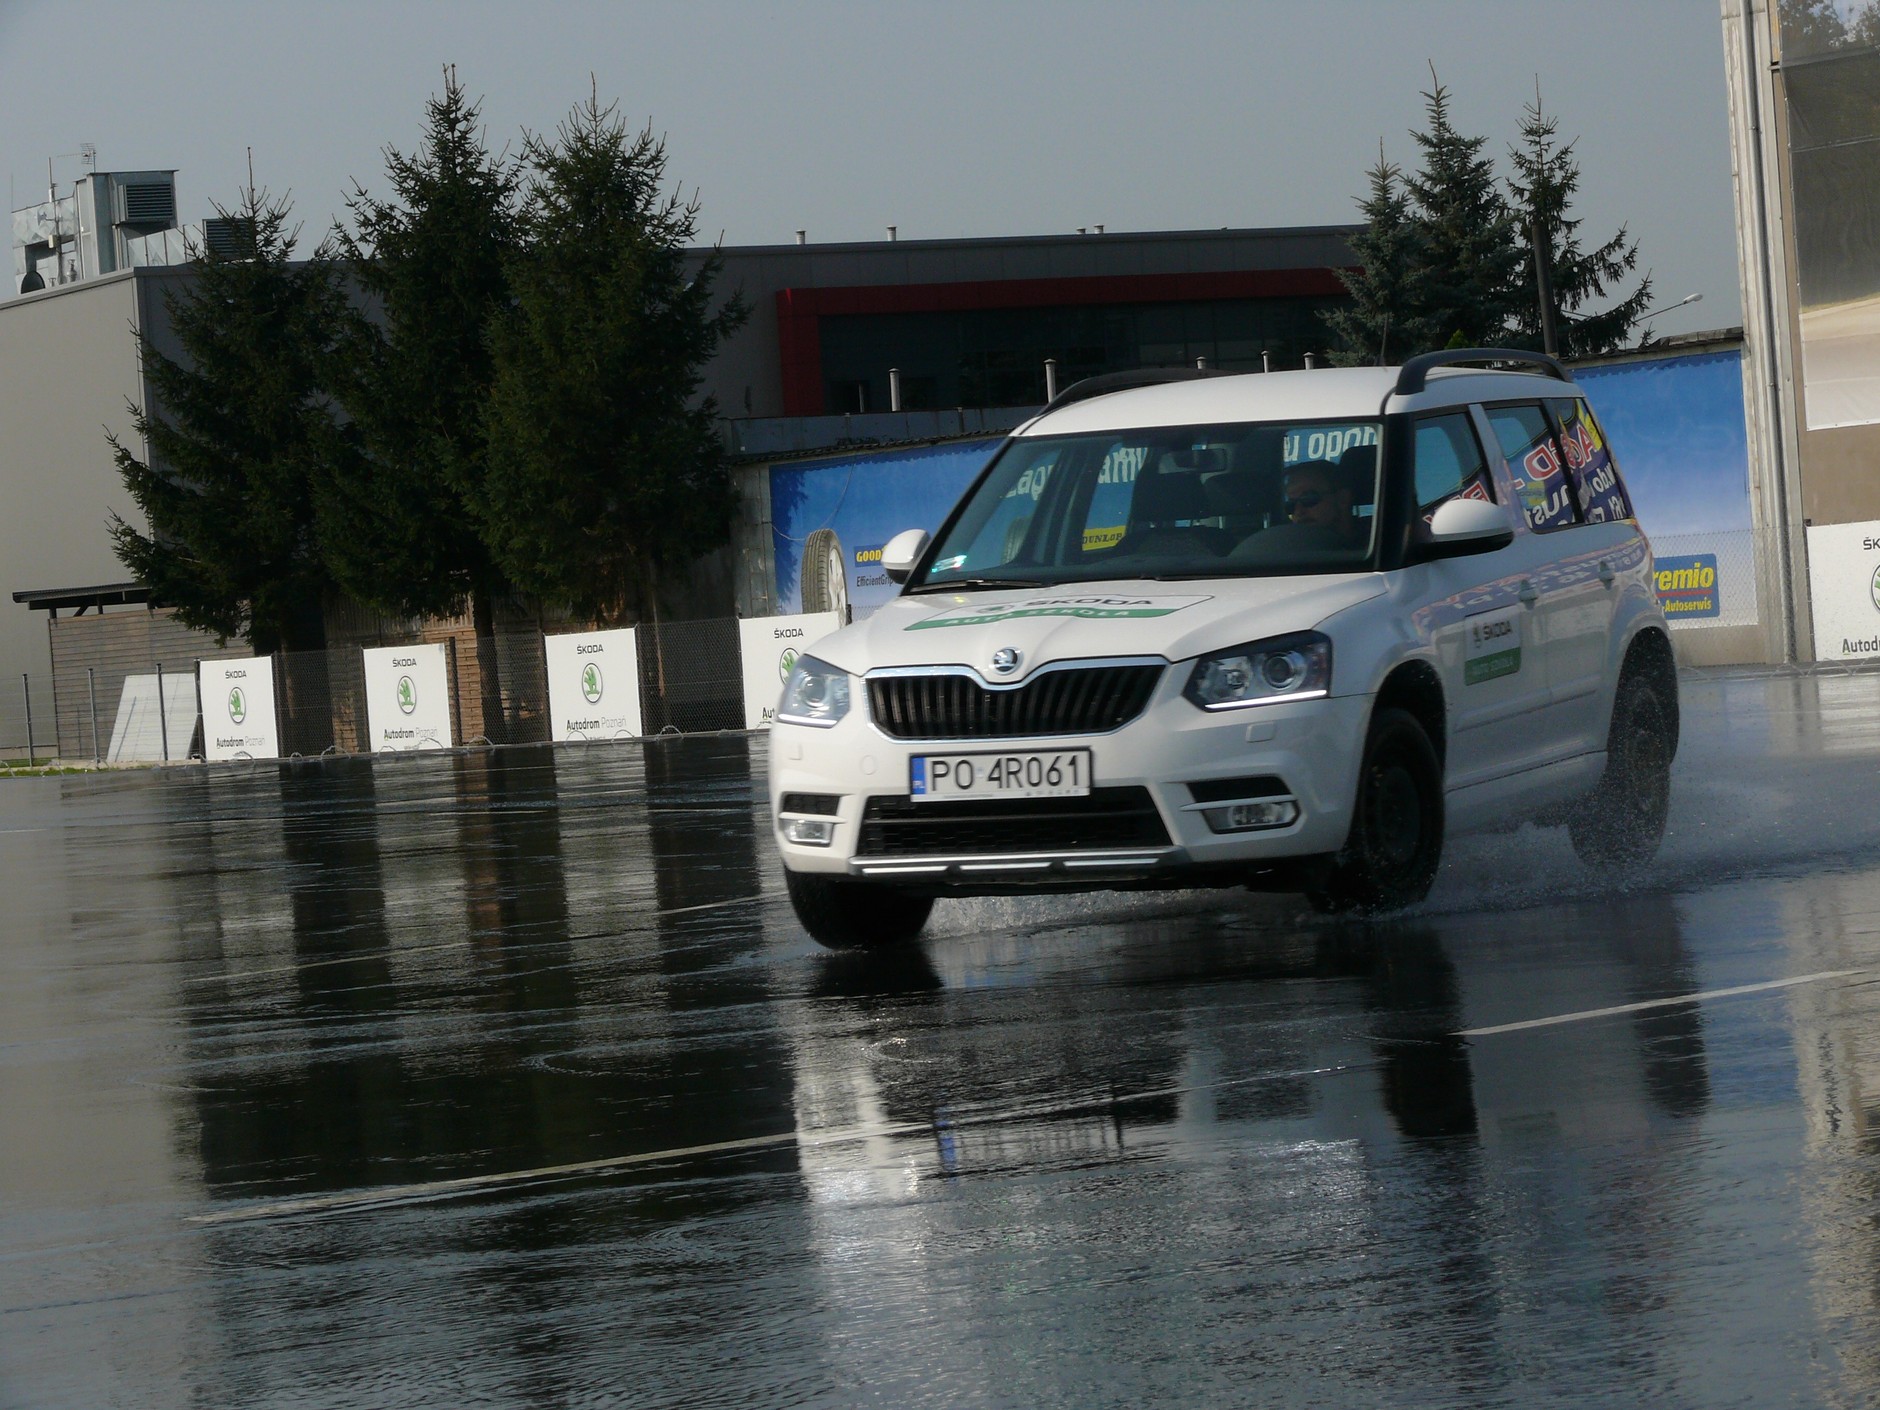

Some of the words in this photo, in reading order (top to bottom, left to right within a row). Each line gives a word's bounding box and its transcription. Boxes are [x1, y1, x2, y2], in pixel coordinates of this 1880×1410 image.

[773, 627, 804, 639] ŠKODA
[576, 643, 604, 655] ŠKODA
[392, 657, 417, 668] ŠKODA
[224, 669, 247, 680] ŠKODA
[566, 716, 600, 731] Autodrom
[383, 726, 415, 741] Autodrom
[216, 736, 244, 749] Autodrom
[930, 758, 974, 792] PO
[987, 754, 1079, 789] 4R061
